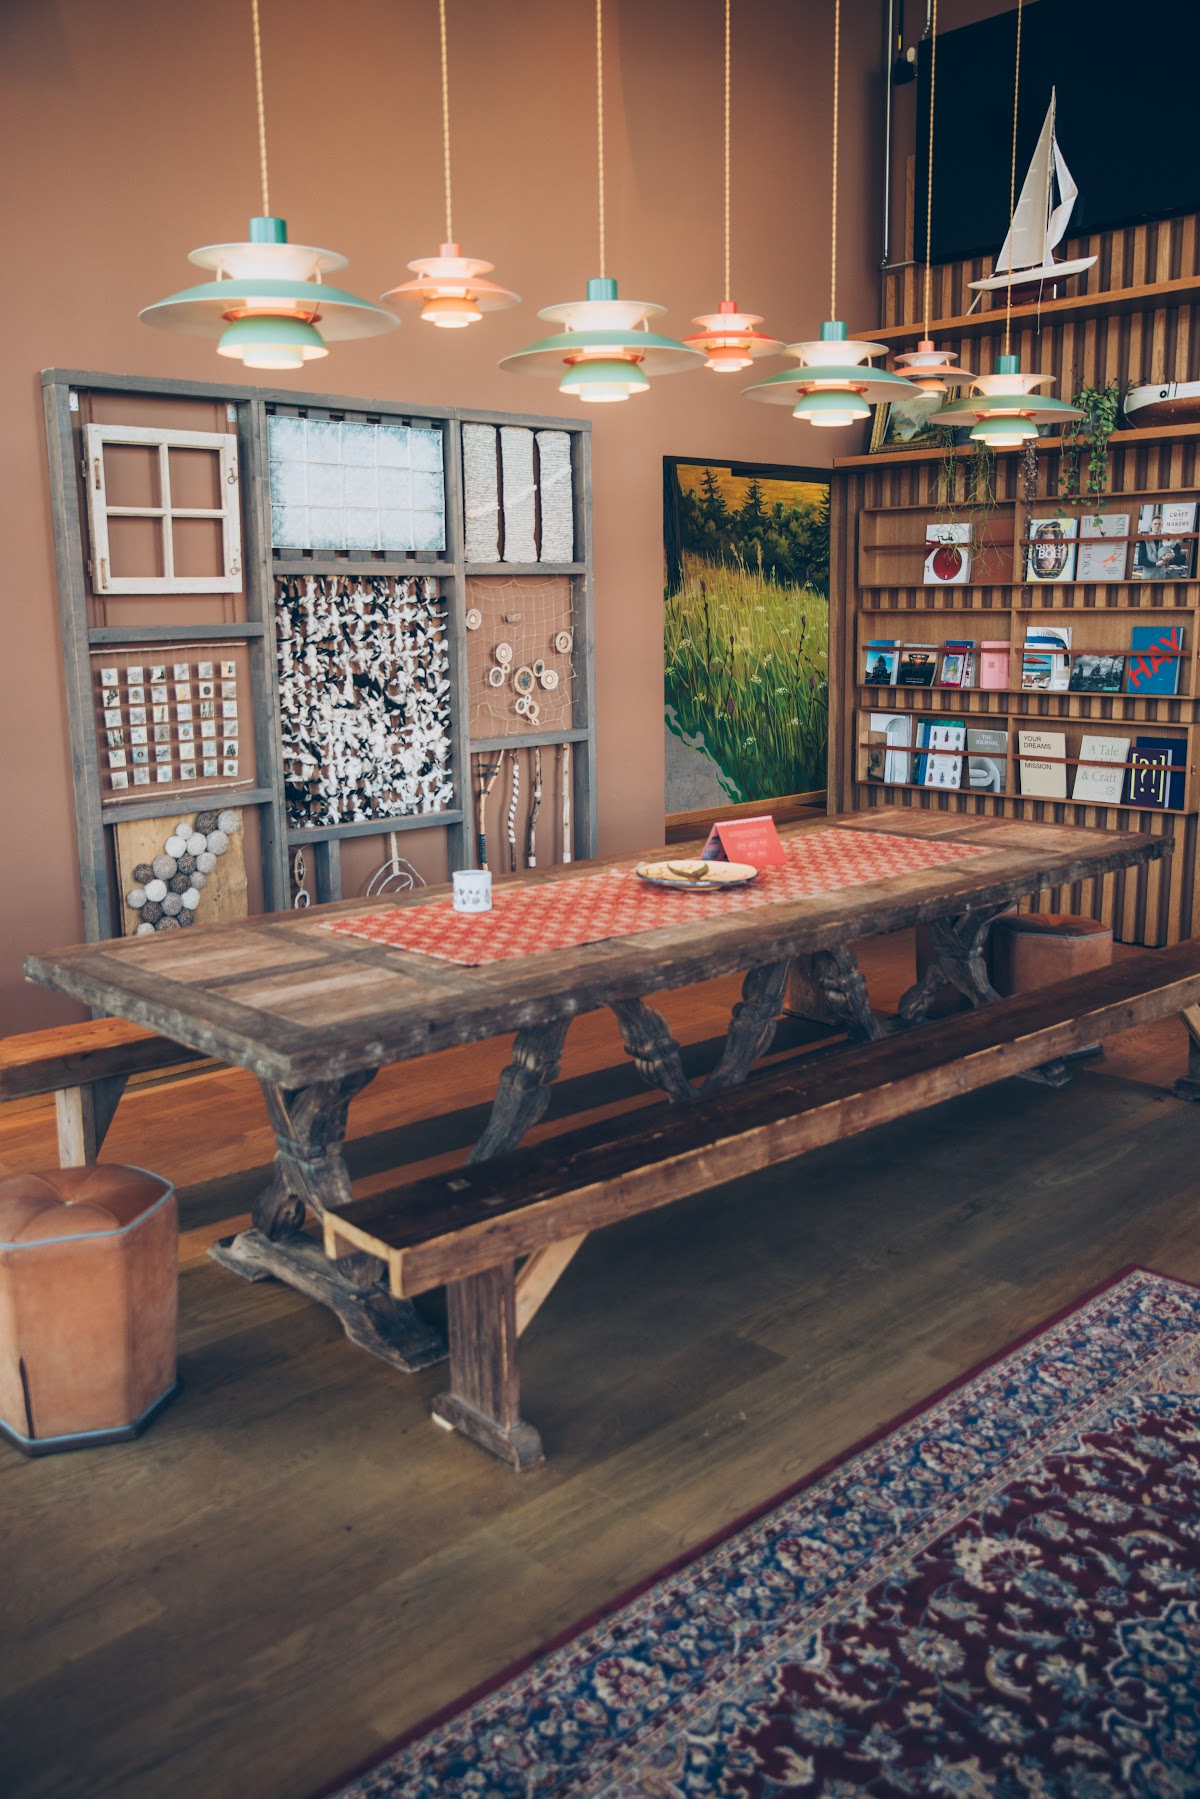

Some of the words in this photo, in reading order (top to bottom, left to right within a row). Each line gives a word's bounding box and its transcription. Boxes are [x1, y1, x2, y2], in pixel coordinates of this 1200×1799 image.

[1038, 549, 1061, 559] BOG
[1128, 627, 1179, 687] HAY
[1023, 742, 1052, 750] DREAMS
[1088, 744, 1096, 755] A
[1098, 744, 1119, 757] Tale
[1024, 762, 1052, 770] MISSION
[1081, 771, 1089, 780] &
[1091, 770, 1117, 783] Craft
